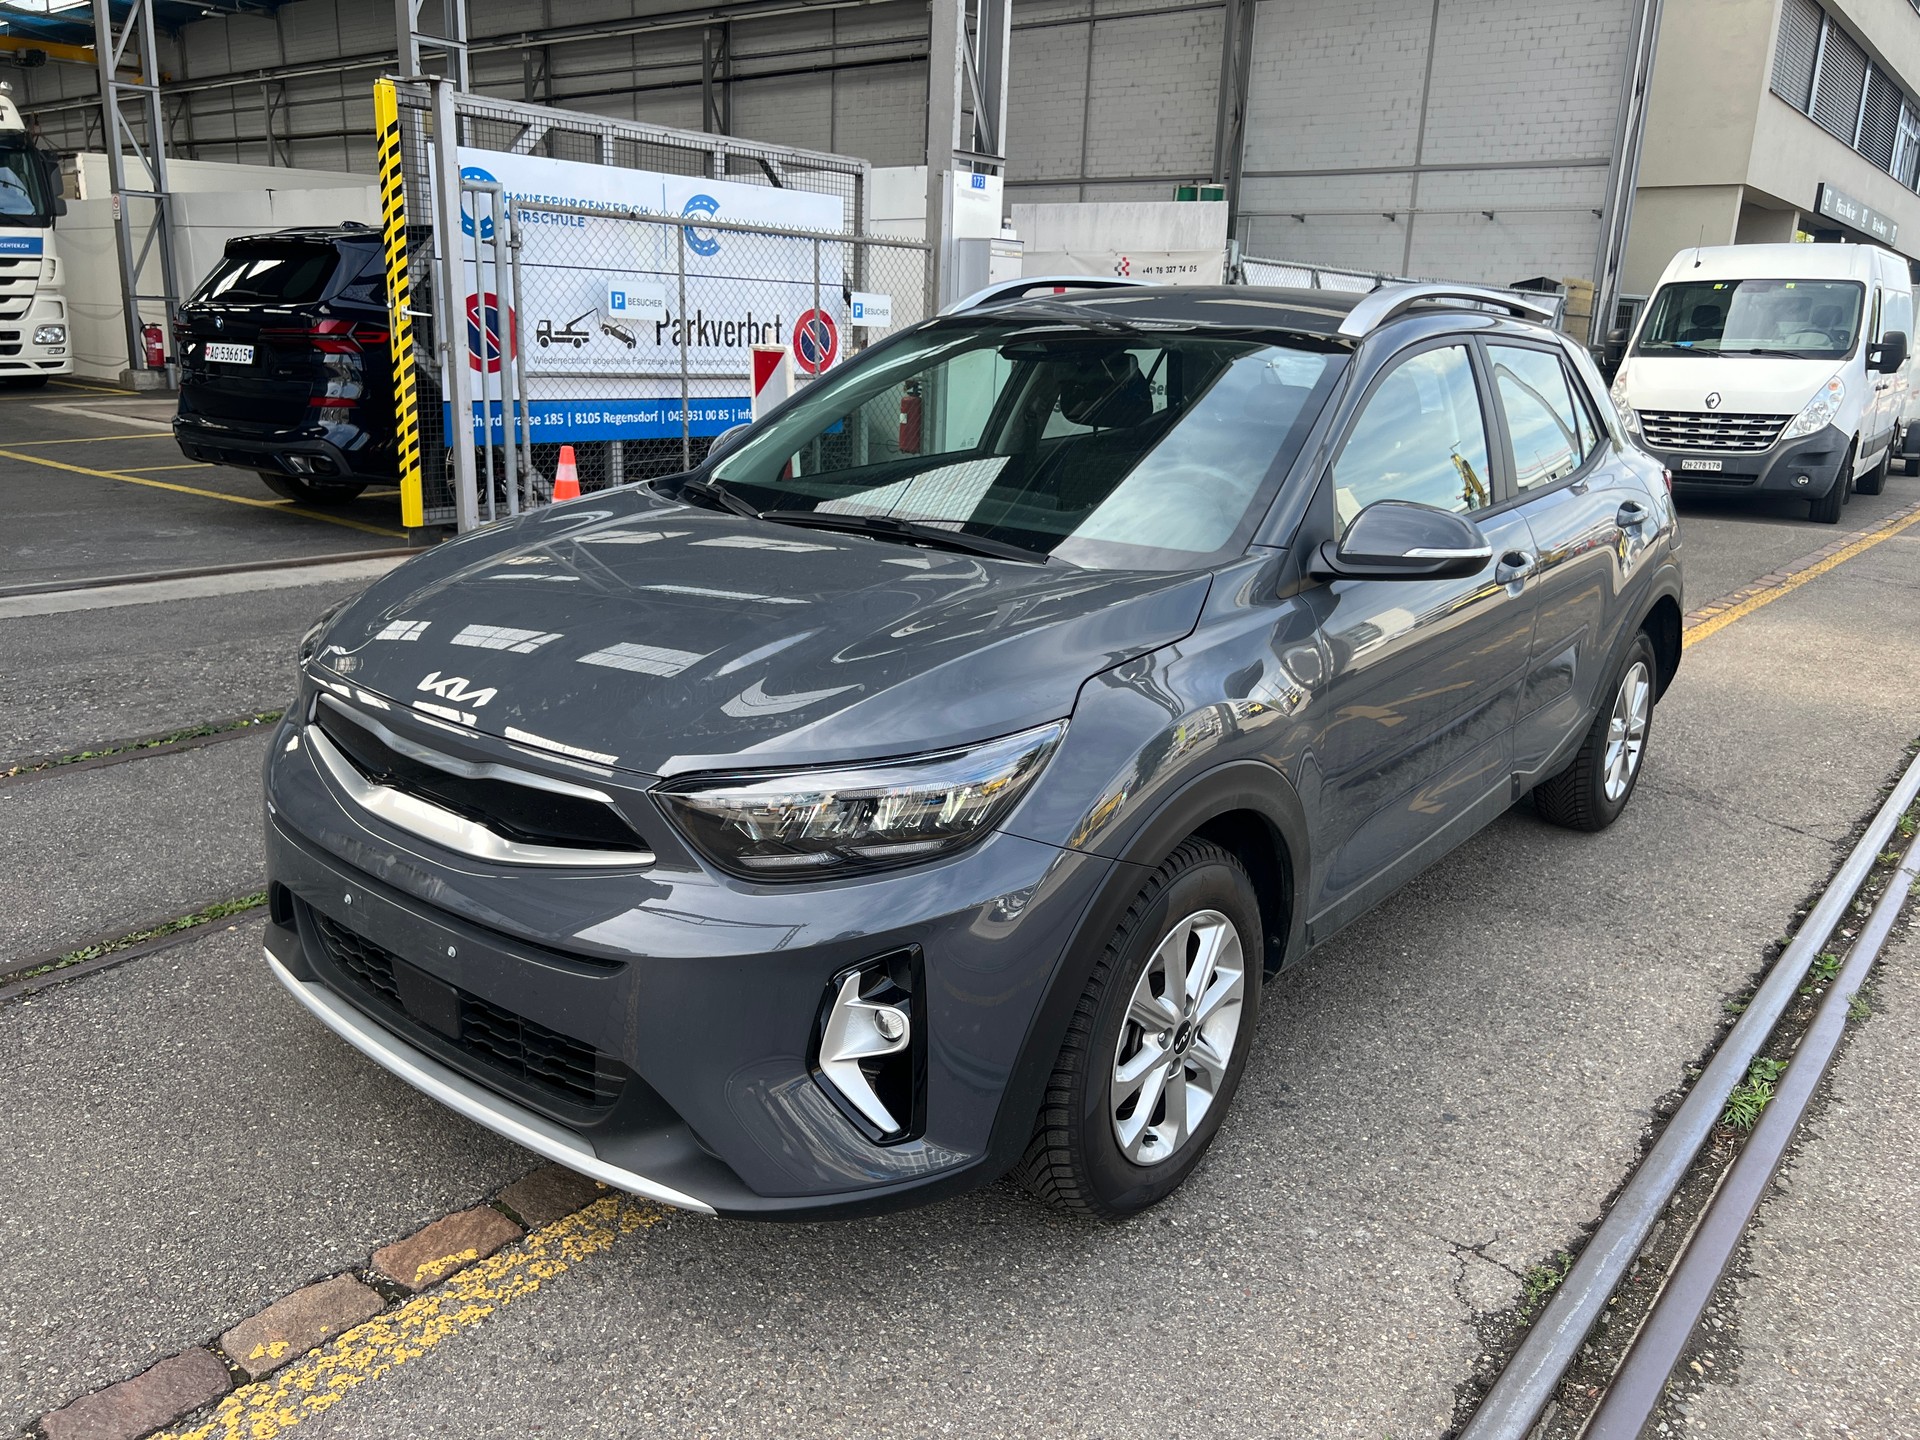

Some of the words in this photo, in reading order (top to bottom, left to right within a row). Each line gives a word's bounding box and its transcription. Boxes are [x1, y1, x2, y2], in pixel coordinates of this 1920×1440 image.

[973, 176, 984, 187] 173
[1179, 265, 1186, 273] 74
[627, 297, 663, 308] BESUCHER
[864, 307, 889, 316] BESUCHER
[544, 413, 564, 425] 185
[575, 412, 601, 425] 8105
[603, 410, 659, 426] Regensdorf
[688, 410, 703, 421] 931
[705, 409, 717, 421] 00
[718, 409, 729, 420] 85
[416, 670, 499, 708] KIA
